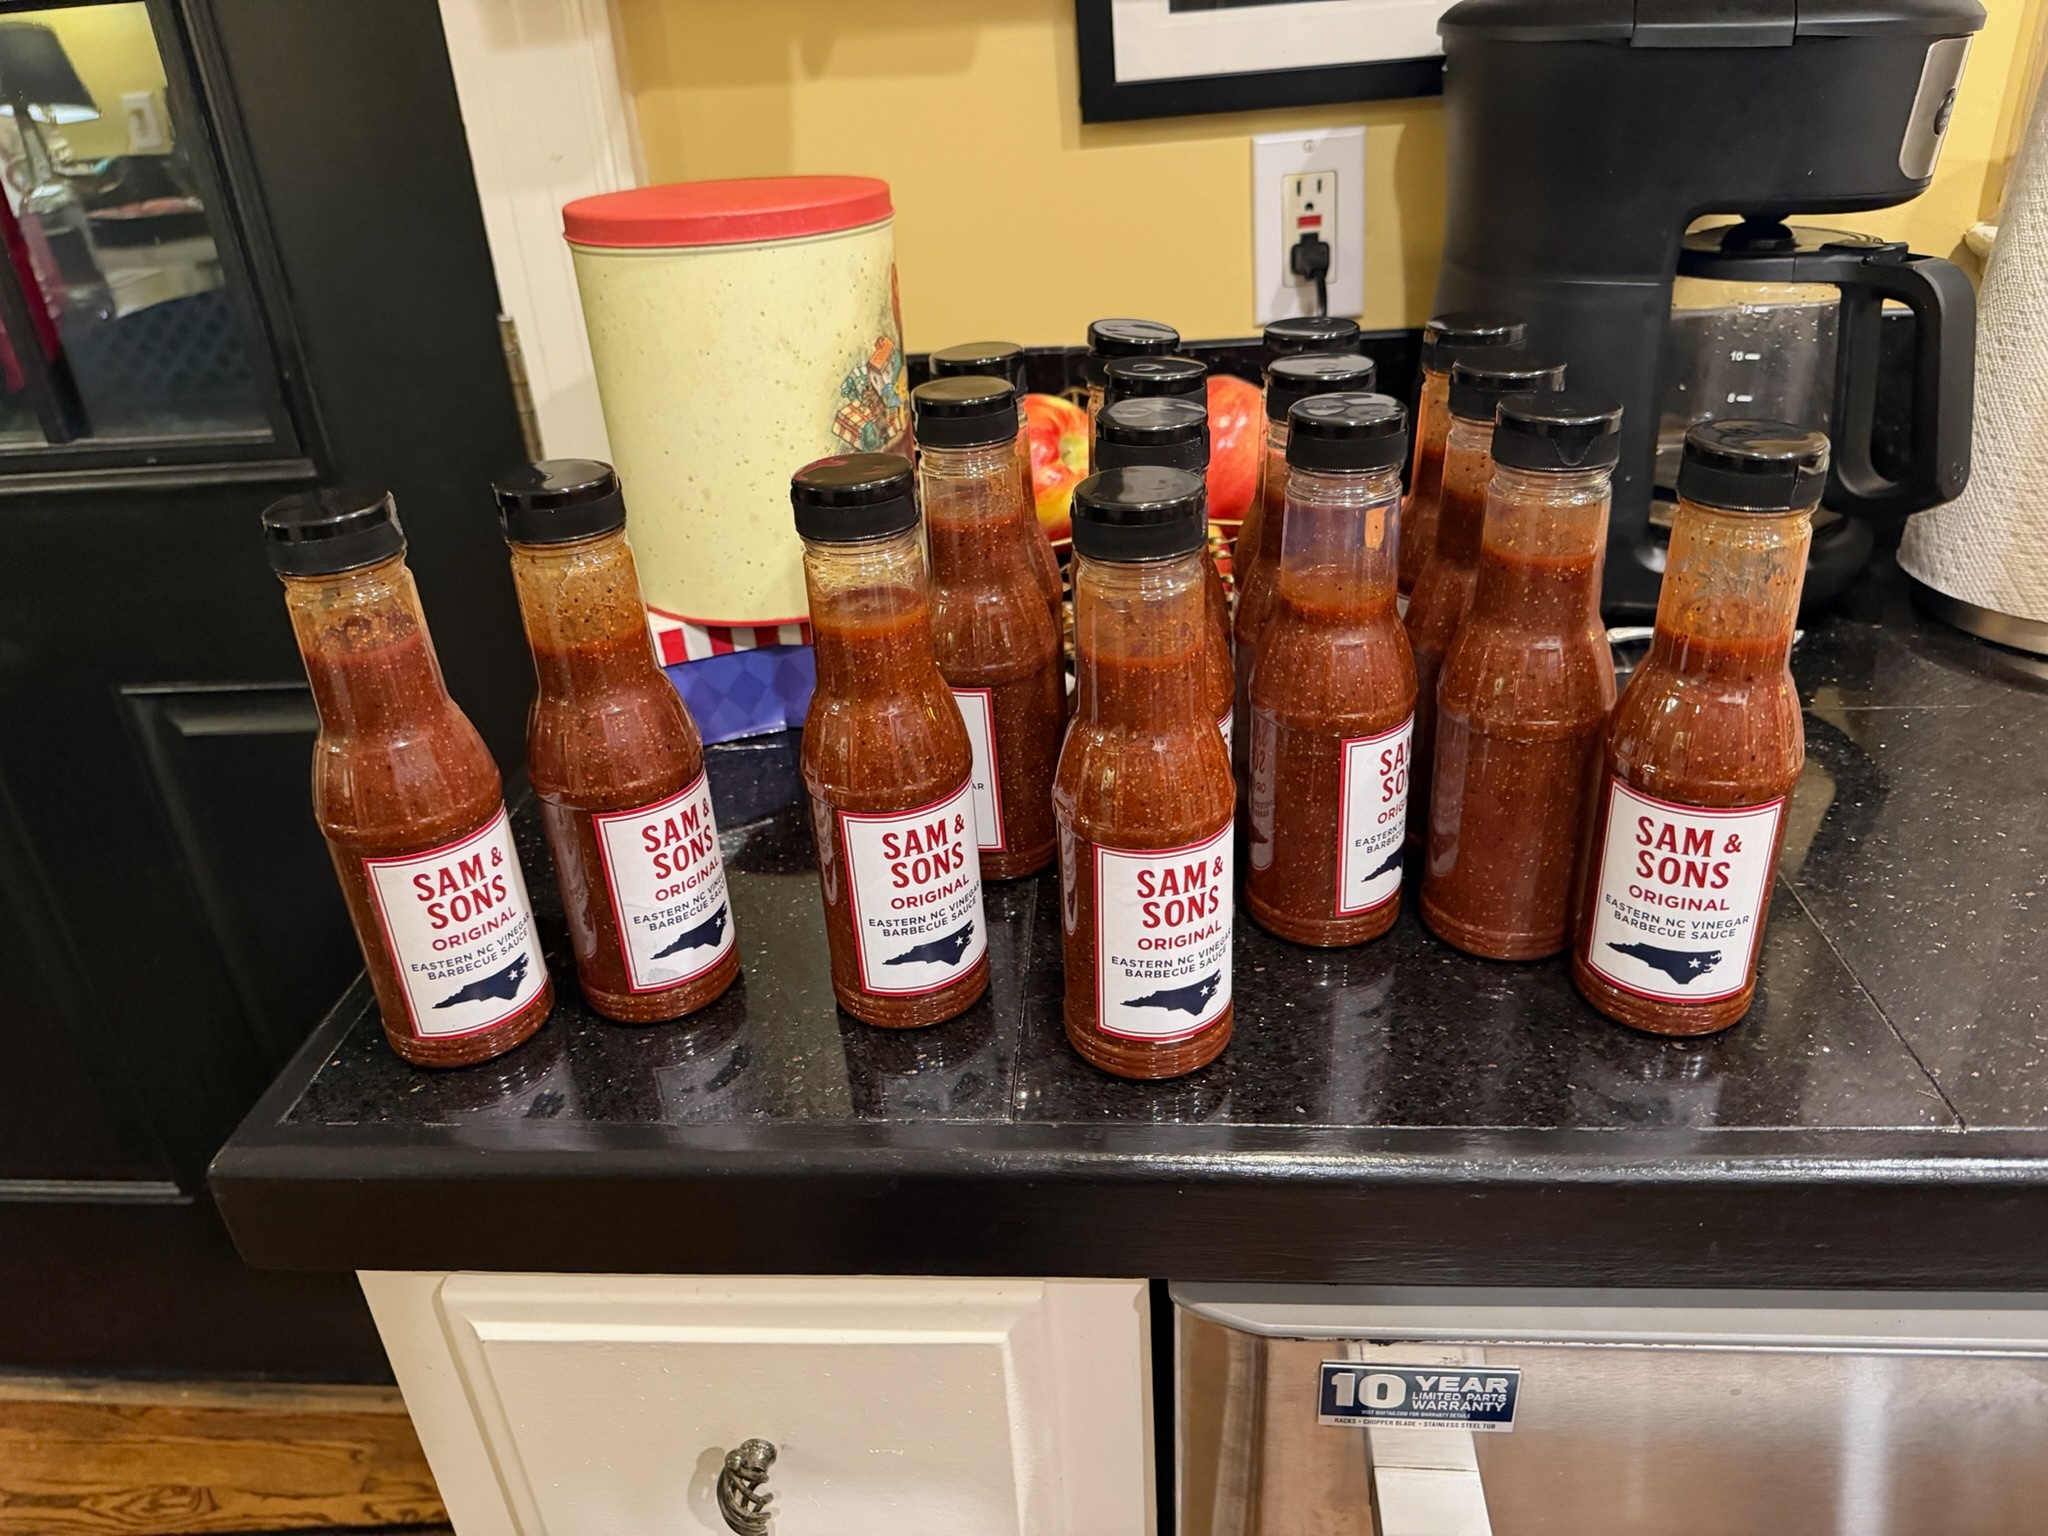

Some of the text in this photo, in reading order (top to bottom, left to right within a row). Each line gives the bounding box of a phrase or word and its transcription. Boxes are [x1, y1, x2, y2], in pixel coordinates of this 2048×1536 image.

[1729, 351, 1744, 361] 10
[642, 797, 710, 853] SAM &
[882, 813, 965, 860] SAM &
[1355, 824, 1397, 847] EASTERN
[1636, 816, 1743, 858] SAM &
[653, 824, 713, 880] SONS
[891, 841, 964, 888] SONS
[1636, 850, 1731, 889] SONS
[413, 846, 503, 901] SAM &
[655, 856, 719, 901] ORIGINAL
[890, 873, 969, 910] ORIGINAL
[1137, 856, 1223, 898] SAM &
[427, 874, 507, 929] SONS
[633, 902, 690, 924] EASTERN
[693, 892, 706, 906] NC
[649, 901, 709, 931] BARBECUE
[869, 880, 979, 928] EASTERN NC VINEGAR
[883, 896, 977, 937] BARBECUE SAUCE
[1142, 885, 1219, 929] SONS
[1605, 893, 1750, 930] EASTERN NC VINEGAR
[1628, 884, 1730, 912] ORIGINAL
[411, 911, 530, 972] EASTERN NC VINEGAR
[432, 906, 517, 951] ORIGINAL
[1137, 920, 1222, 950] ORIGINAL
[1614, 910, 1736, 940] BARBECUE SAUCE
[427, 928, 529, 981] BARBECUE SAUCE
[1111, 956, 1173, 968] EASTERN
[1177, 954, 1195, 966] NC
[1125, 945, 1226, 978] BARBECUE SAUCE
[1331, 1372, 1509, 1409] 10 YEAR
[1411, 1391, 1507, 1403] LIMITED PARTS
[1412, 1400, 1506, 1413] WARRANTY
[1423, 1421, 1459, 1429] STAINLESS
